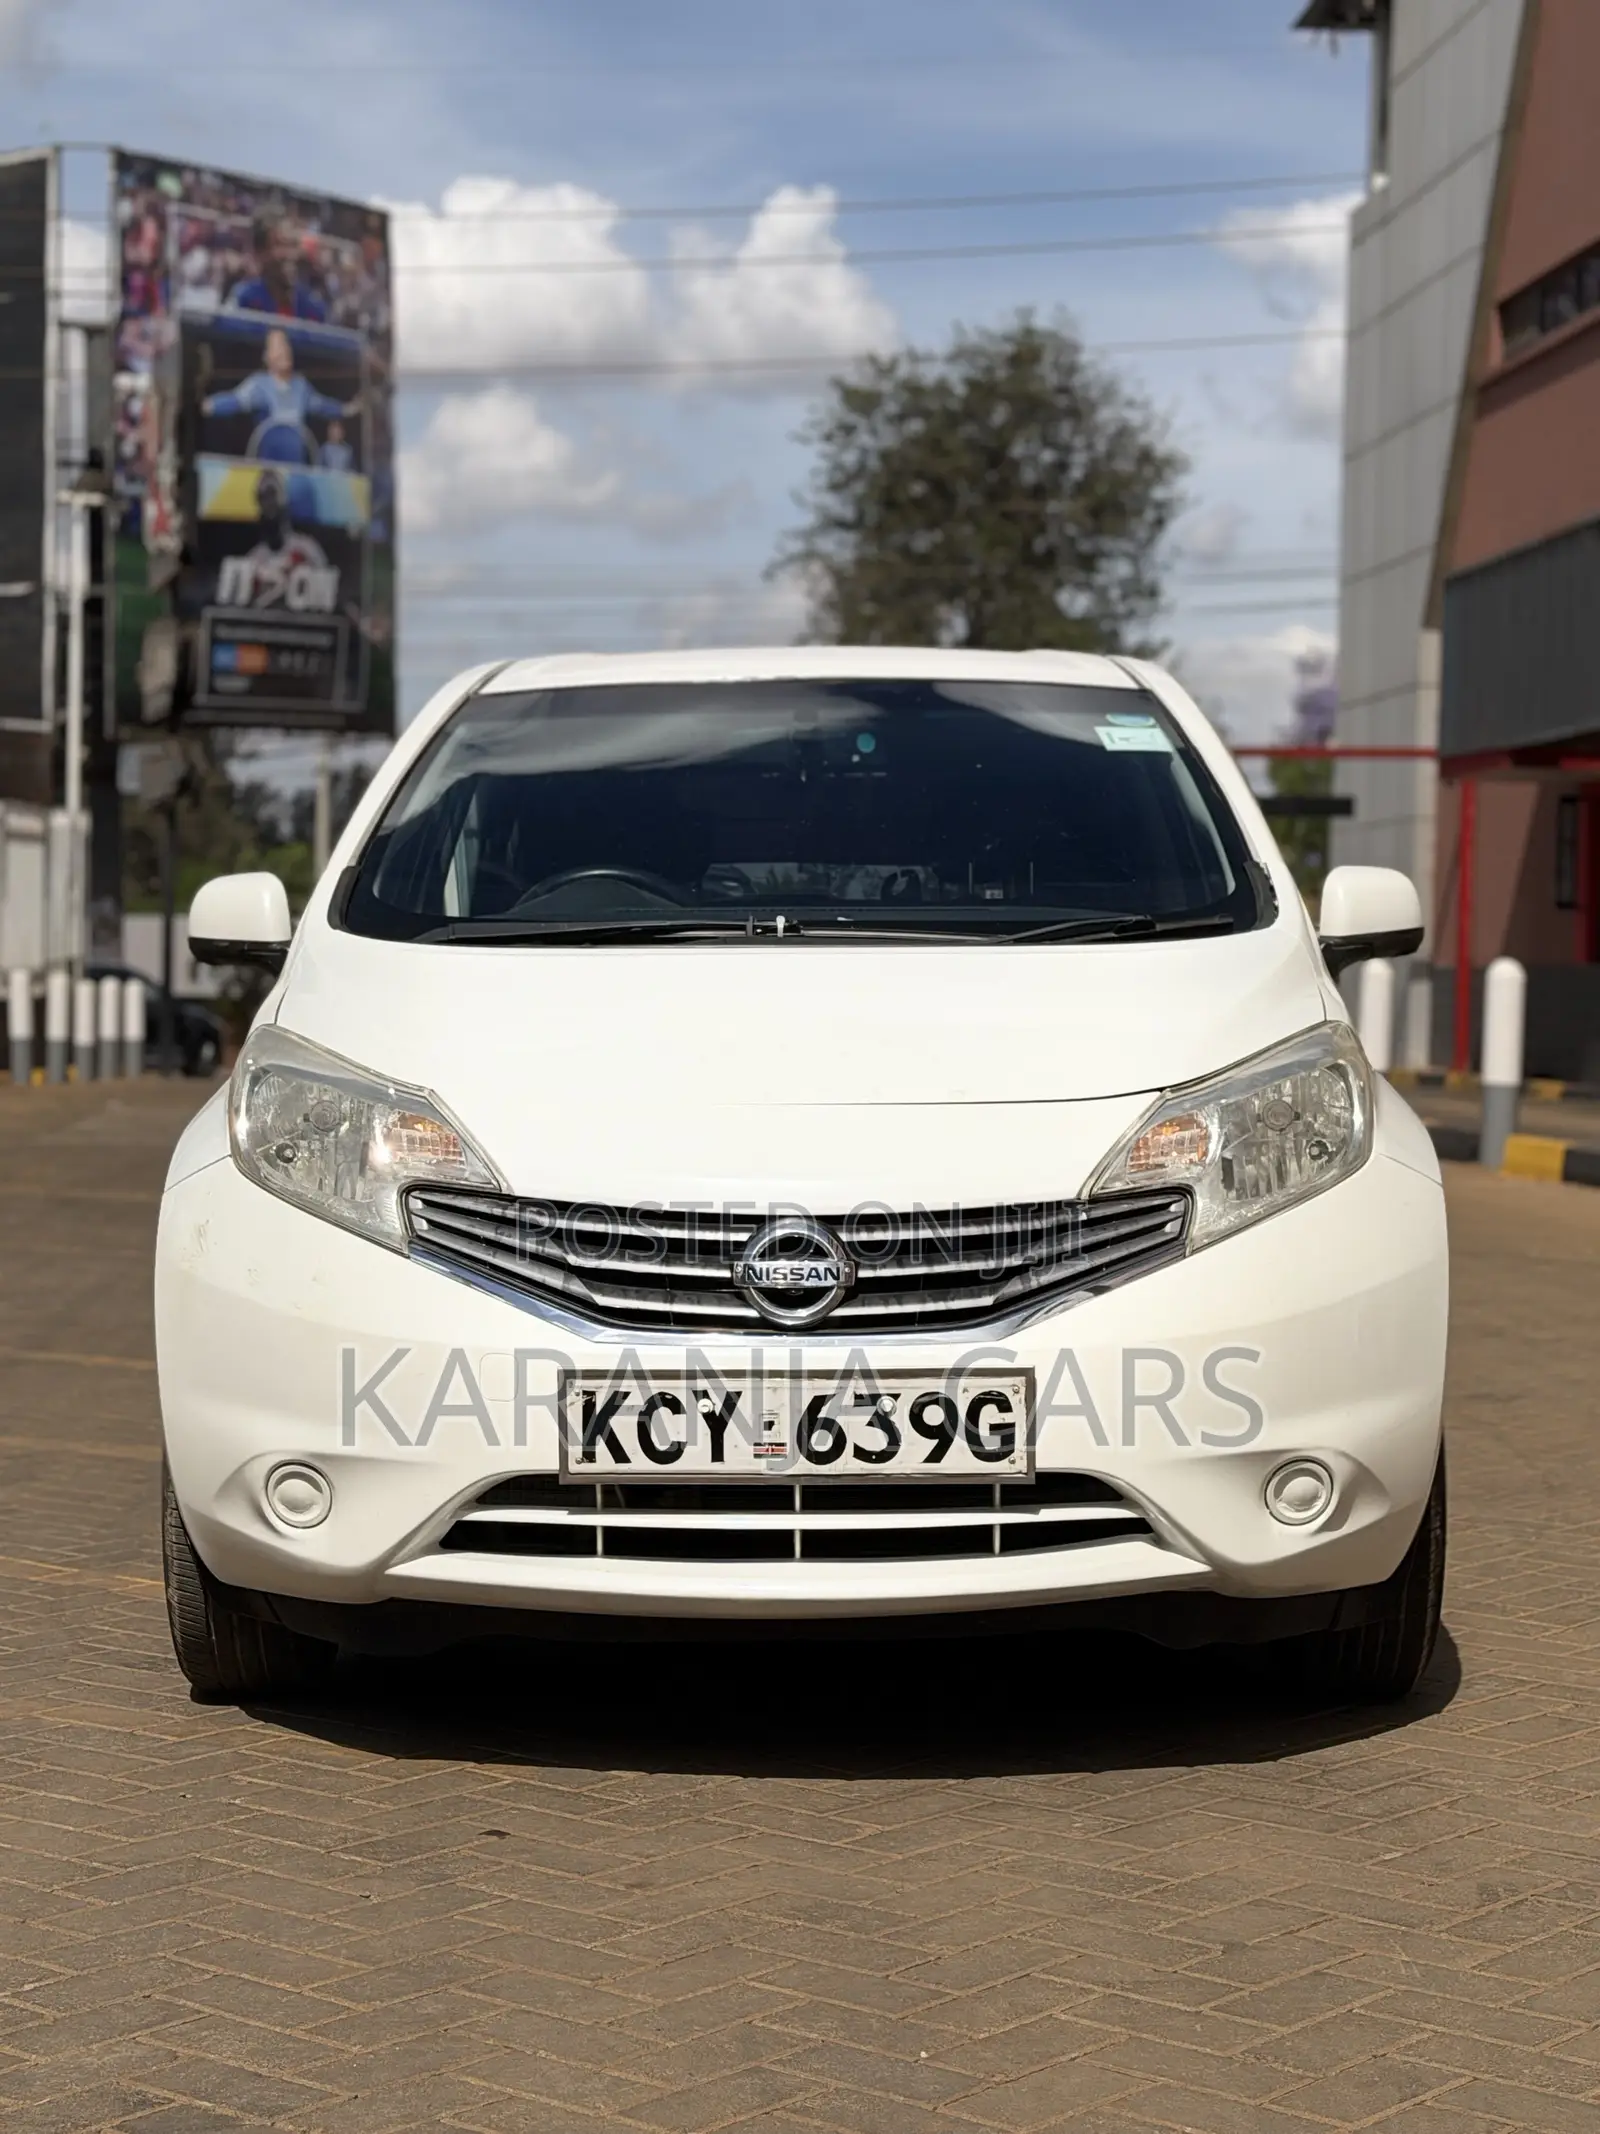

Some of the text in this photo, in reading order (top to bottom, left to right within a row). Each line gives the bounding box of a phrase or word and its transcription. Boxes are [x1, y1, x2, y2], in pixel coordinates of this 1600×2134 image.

[744, 1263, 841, 1283] NISSAN
[581, 1388, 1018, 1467] KCY 639G
